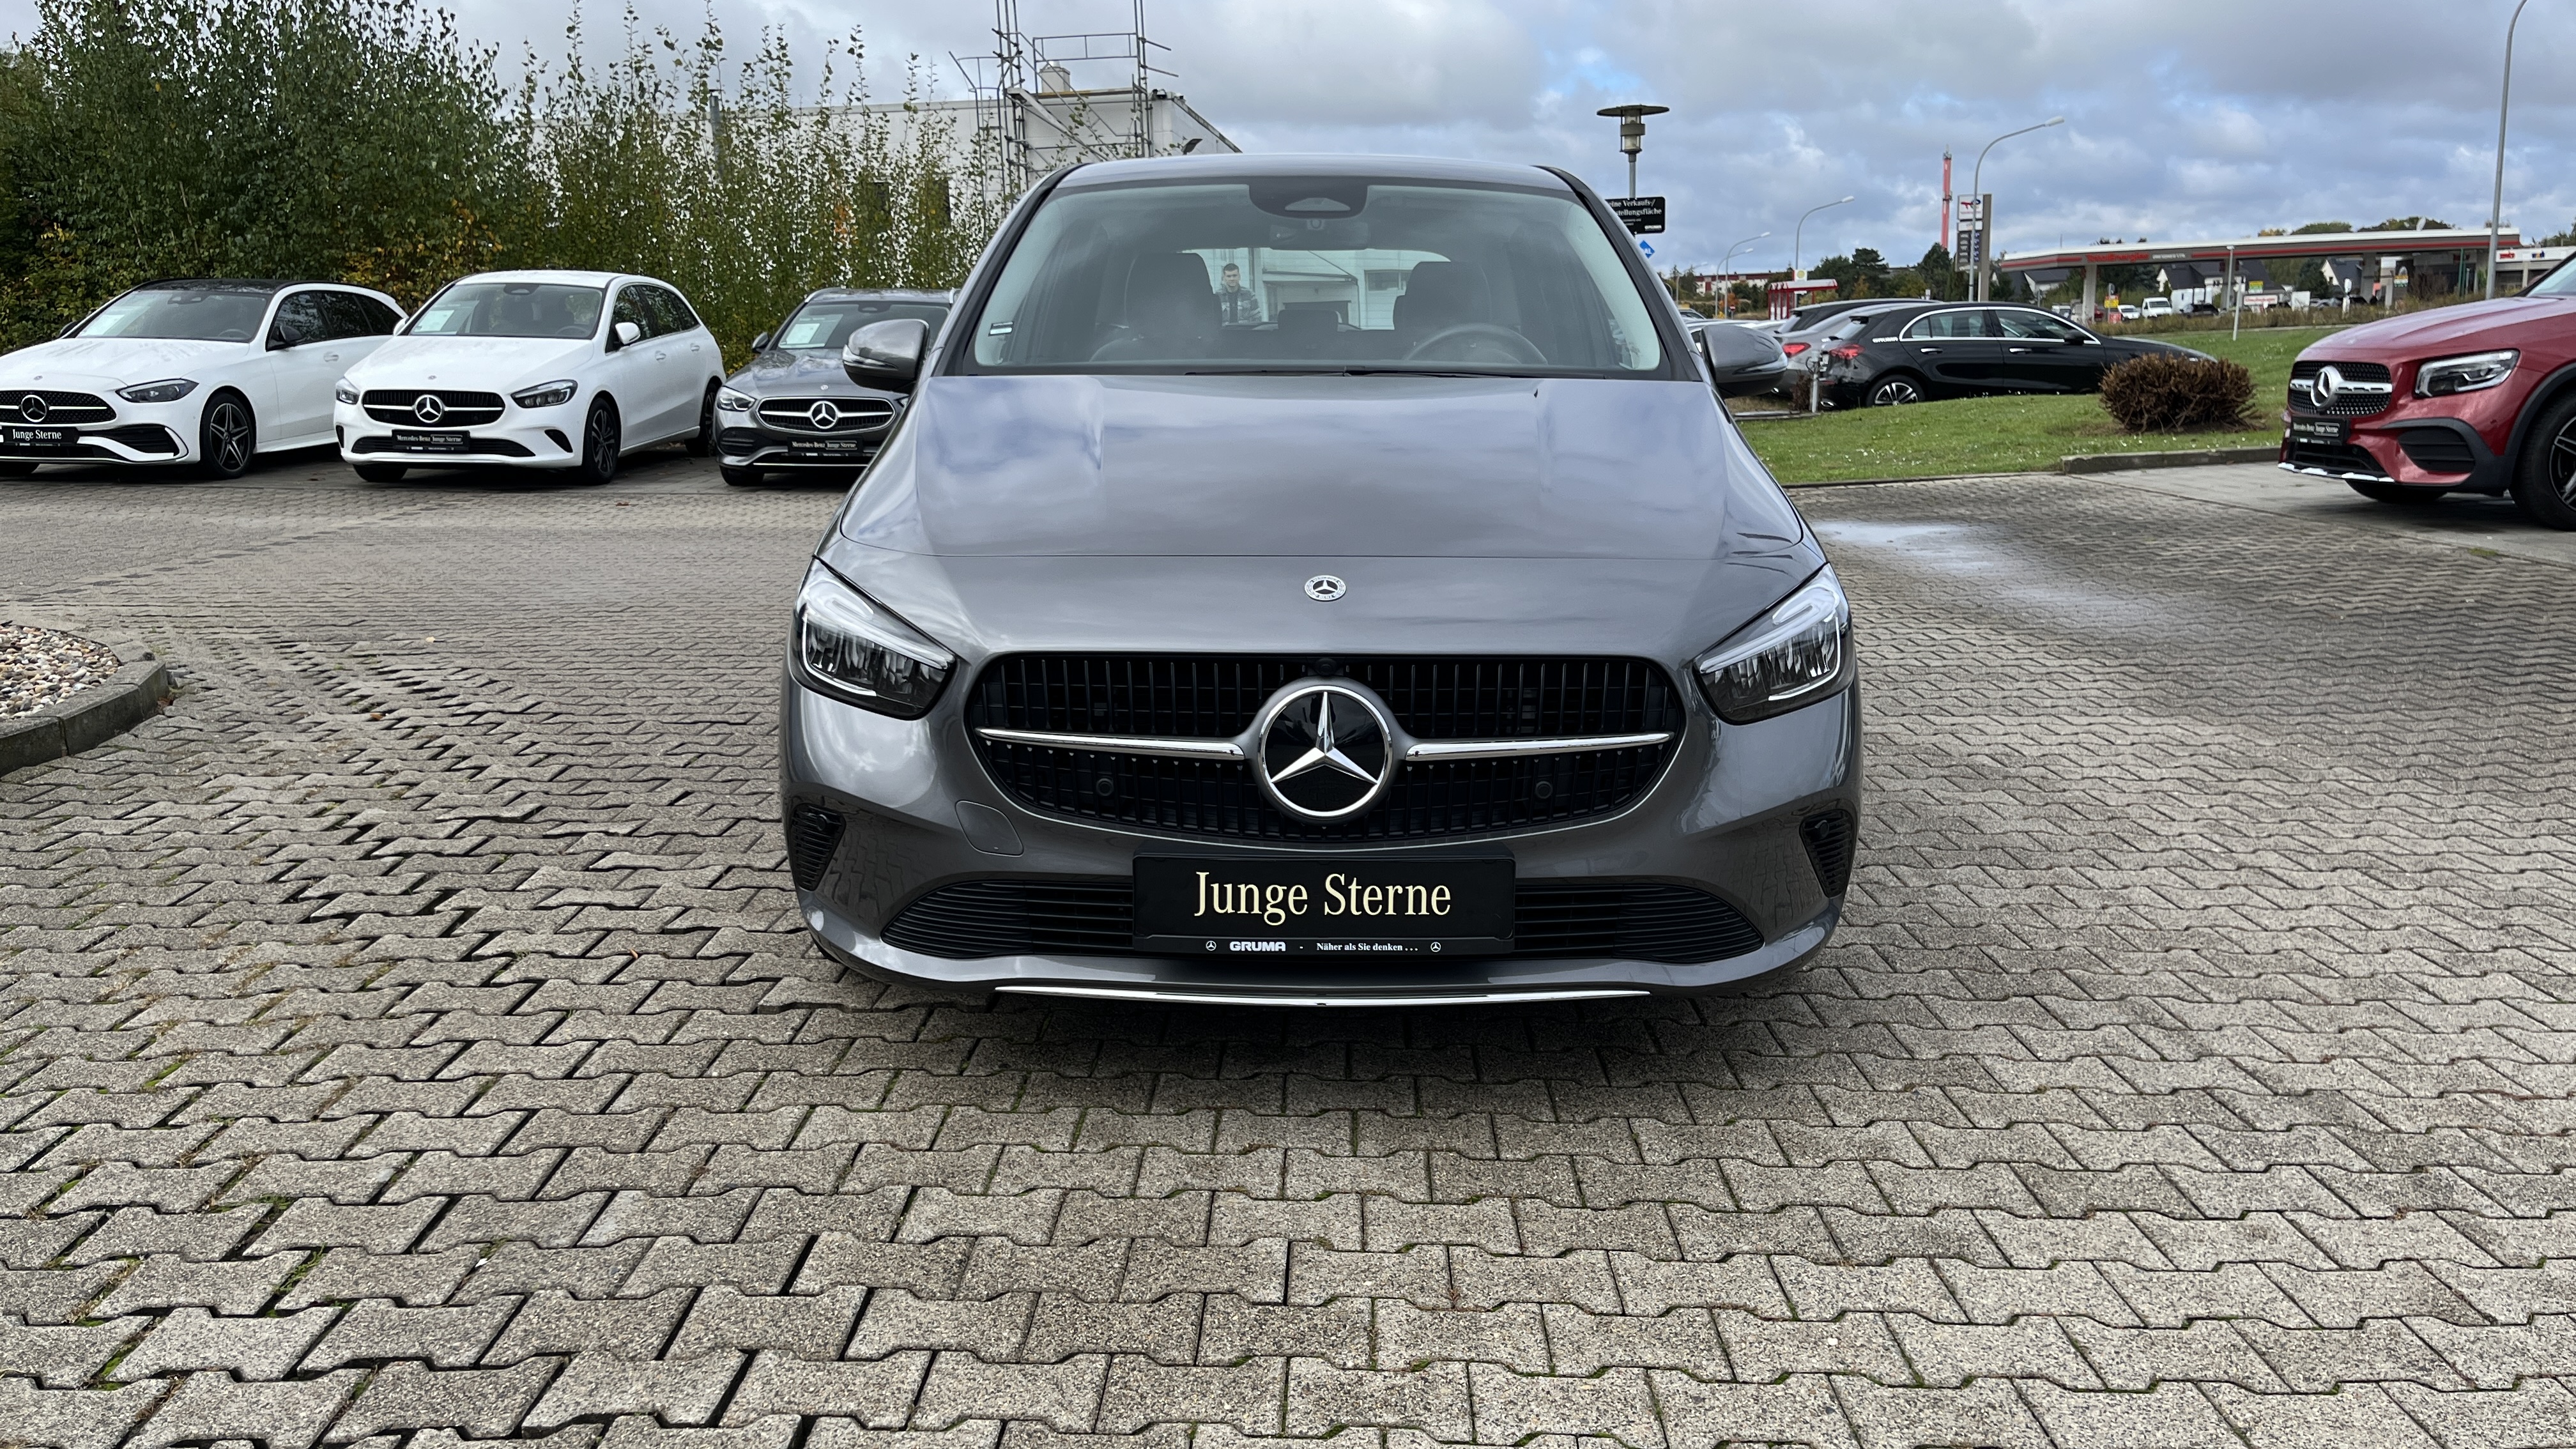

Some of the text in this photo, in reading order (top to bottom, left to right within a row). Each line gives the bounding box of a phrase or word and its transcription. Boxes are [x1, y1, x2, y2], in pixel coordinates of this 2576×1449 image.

[13, 429, 62, 441] Junge Sterne
[1194, 871, 1451, 926] Junge Sterne
[1229, 941, 1286, 951] GRUMA
[1316, 942, 1342, 951] Näher
[1344, 942, 1356, 951] als
[1358, 942, 1371, 951] Sie
[1372, 942, 1403, 951] denken
